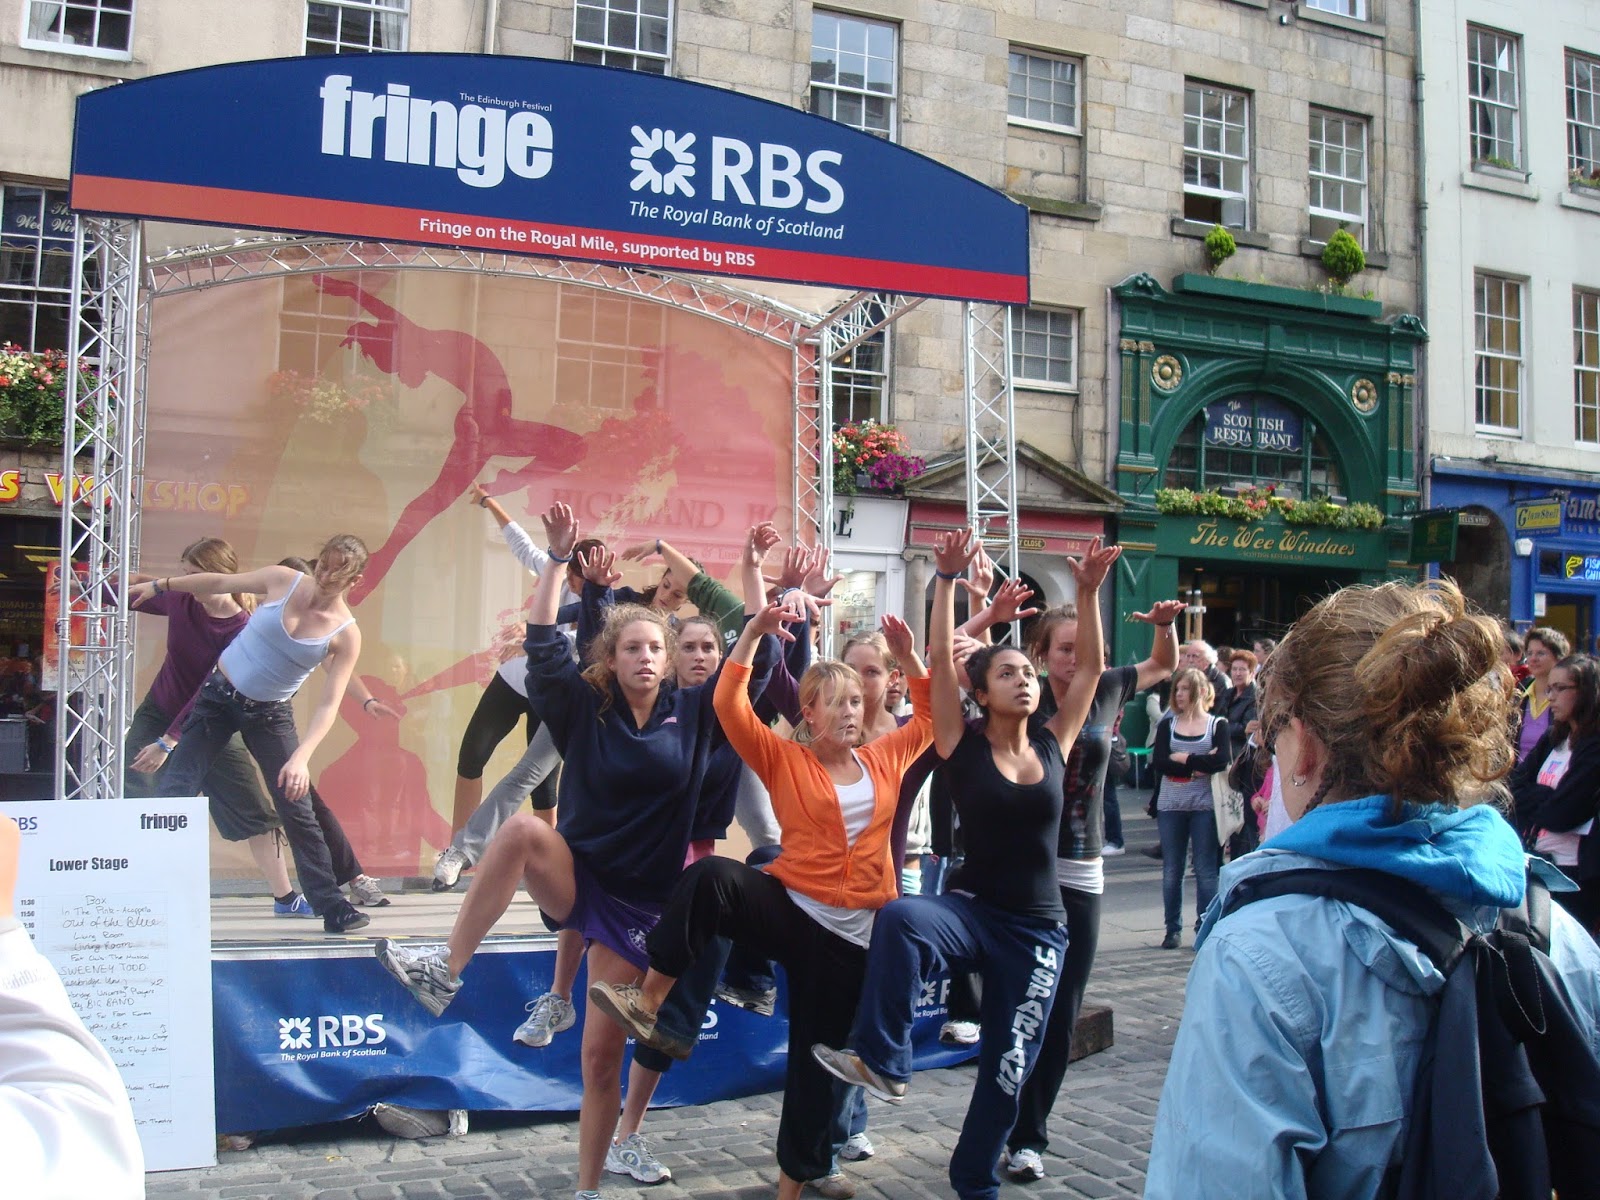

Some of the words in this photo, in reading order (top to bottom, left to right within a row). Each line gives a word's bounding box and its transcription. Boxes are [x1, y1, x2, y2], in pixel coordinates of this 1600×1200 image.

[460, 92, 475, 102] The
[477, 95, 520, 109] Edinburgh
[522, 101, 553, 112] Festival
[320, 74, 553, 188] fringe
[711, 136, 844, 214] RBS
[629, 201, 658, 219] The
[663, 205, 708, 226] Royal
[712, 211, 752, 230] Bank
[755, 216, 775, 236] of
[776, 218, 844, 240] Scotland
[419, 217, 472, 237] Fringe
[475, 225, 496, 239] on
[500, 226, 527, 242] the
[530, 229, 576, 249] Royal
[580, 236, 618, 255] Mile,
[622, 240, 700, 261] supported
[702, 247, 722, 267] by
[725, 251, 755, 267] RBS
[1223, 413, 1284, 431] SCOTTISH
[45, 472, 250, 518] WOKSHOP
[1023, 539, 1043, 548] CLOSE
[1067, 541, 1080, 550] 142
[1190, 518, 1229, 547] The
[1233, 525, 1275, 550] Wee
[1278, 530, 1356, 556] Windaes
[140, 813, 188, 831] fringe
[50, 858, 88, 871] Lower
[91, 857, 129, 871] Stage
[91, 916, 102, 927] of
[102, 917, 124, 927] the
[126, 916, 161, 928] Blue
[1035, 945, 1058, 970] LA
[58, 965, 115, 976] SWEENEY
[119, 963, 147, 972] TODD
[106, 997, 135, 1007] BAND
[922, 1008, 940, 1018] Royal
[318, 1013, 387, 1048] RBS
[625, 1036, 636, 1045] he
[698, 1032, 719, 1041] tland
[995, 967, 1056, 1096] SPARTANS
[280, 1053, 296, 1061] The
[296, 1051, 319, 1062] Royal
[320, 1050, 341, 1058] Bank
[342, 1049, 352, 1058] of
[352, 1047, 387, 1057] Scotland
